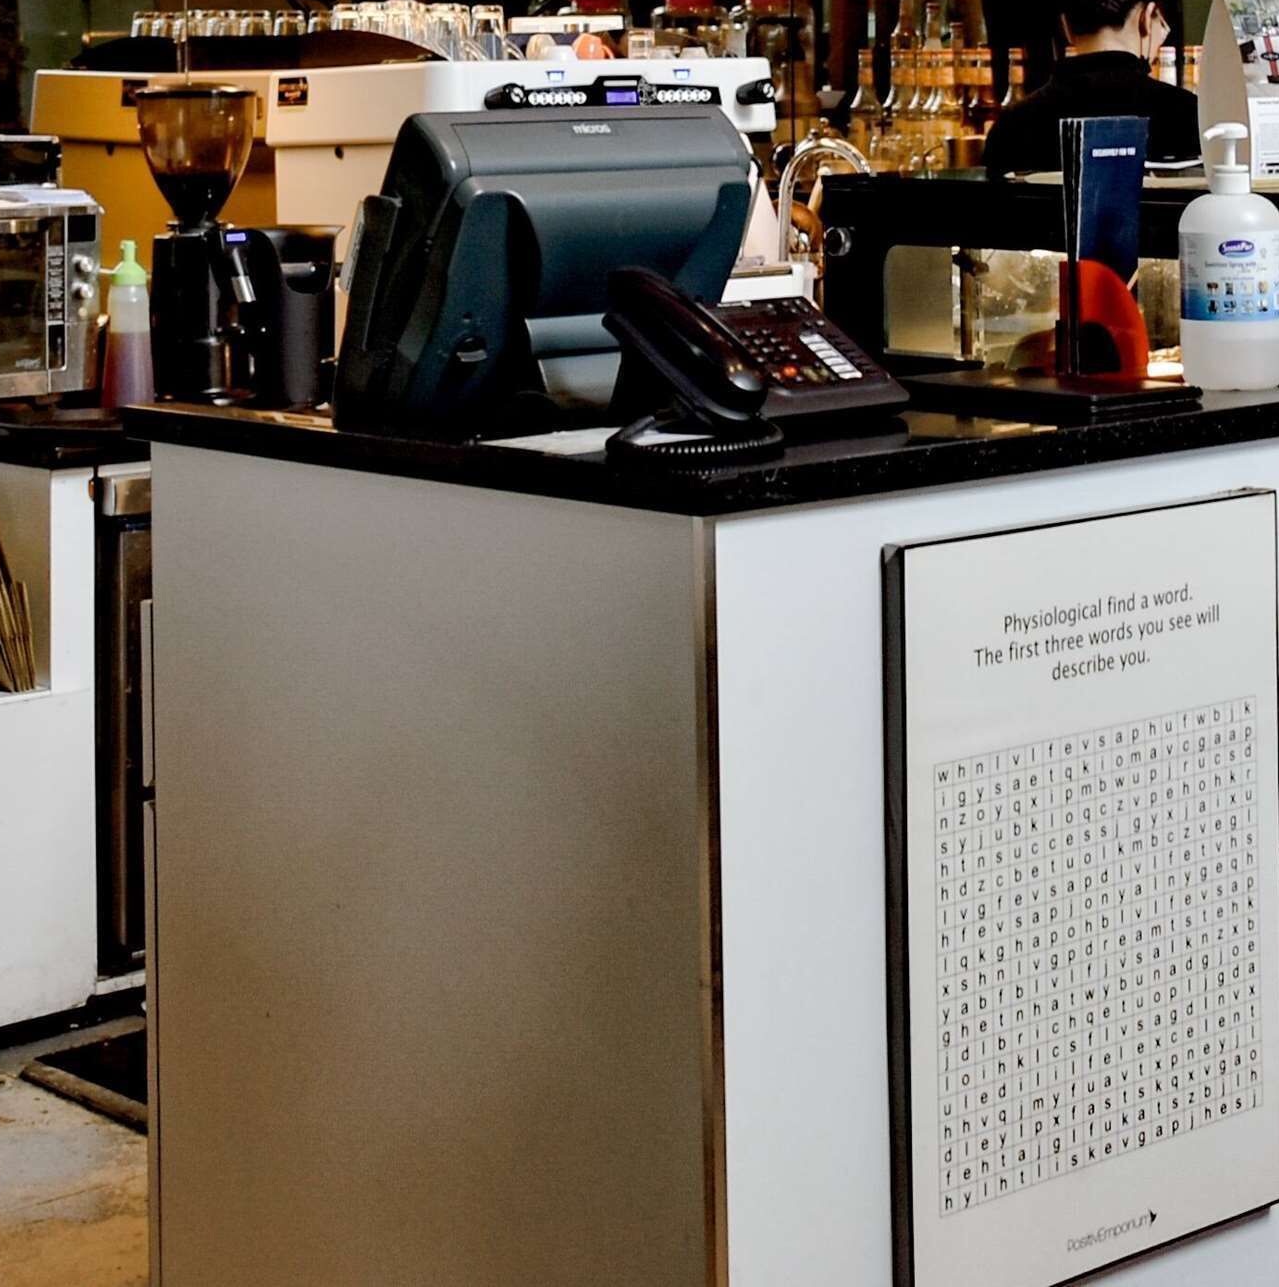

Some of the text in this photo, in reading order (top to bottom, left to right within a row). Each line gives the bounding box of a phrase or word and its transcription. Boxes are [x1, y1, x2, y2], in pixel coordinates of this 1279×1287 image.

[1005, 584, 1192, 634] Physiological find a word.
[974, 605, 1219, 666] The first three words you see will
[1051, 650, 1151, 681] describe you.
